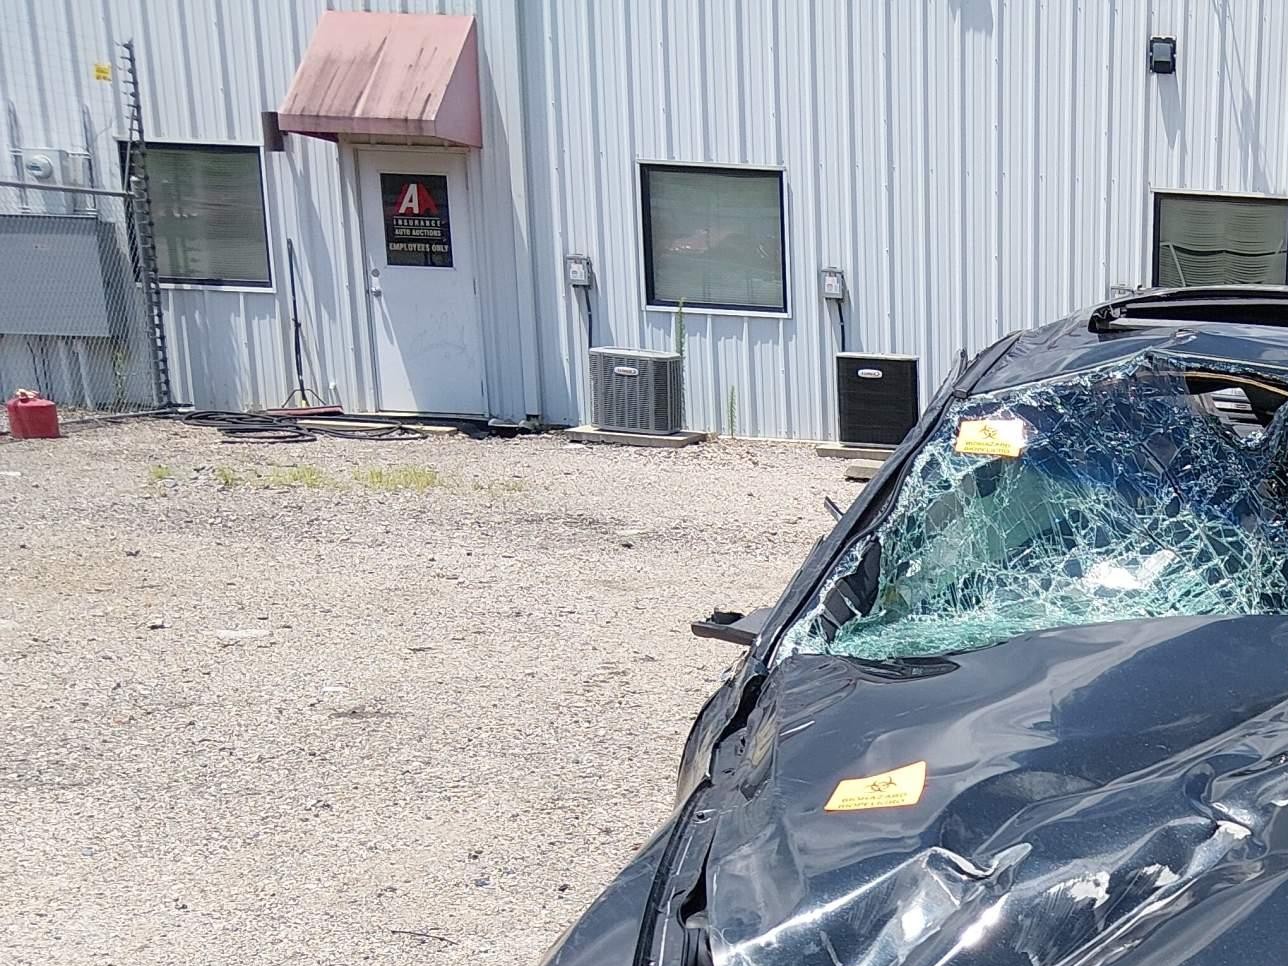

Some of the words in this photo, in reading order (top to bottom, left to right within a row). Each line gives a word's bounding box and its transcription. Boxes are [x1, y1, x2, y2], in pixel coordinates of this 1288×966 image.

[393, 218, 441, 227] INSURANCE
[395, 228, 411, 236] AUTO
[411, 229, 442, 237] AUCTIONS
[389, 242, 430, 252] EMPLOYEES
[431, 244, 449, 252] ONLY
